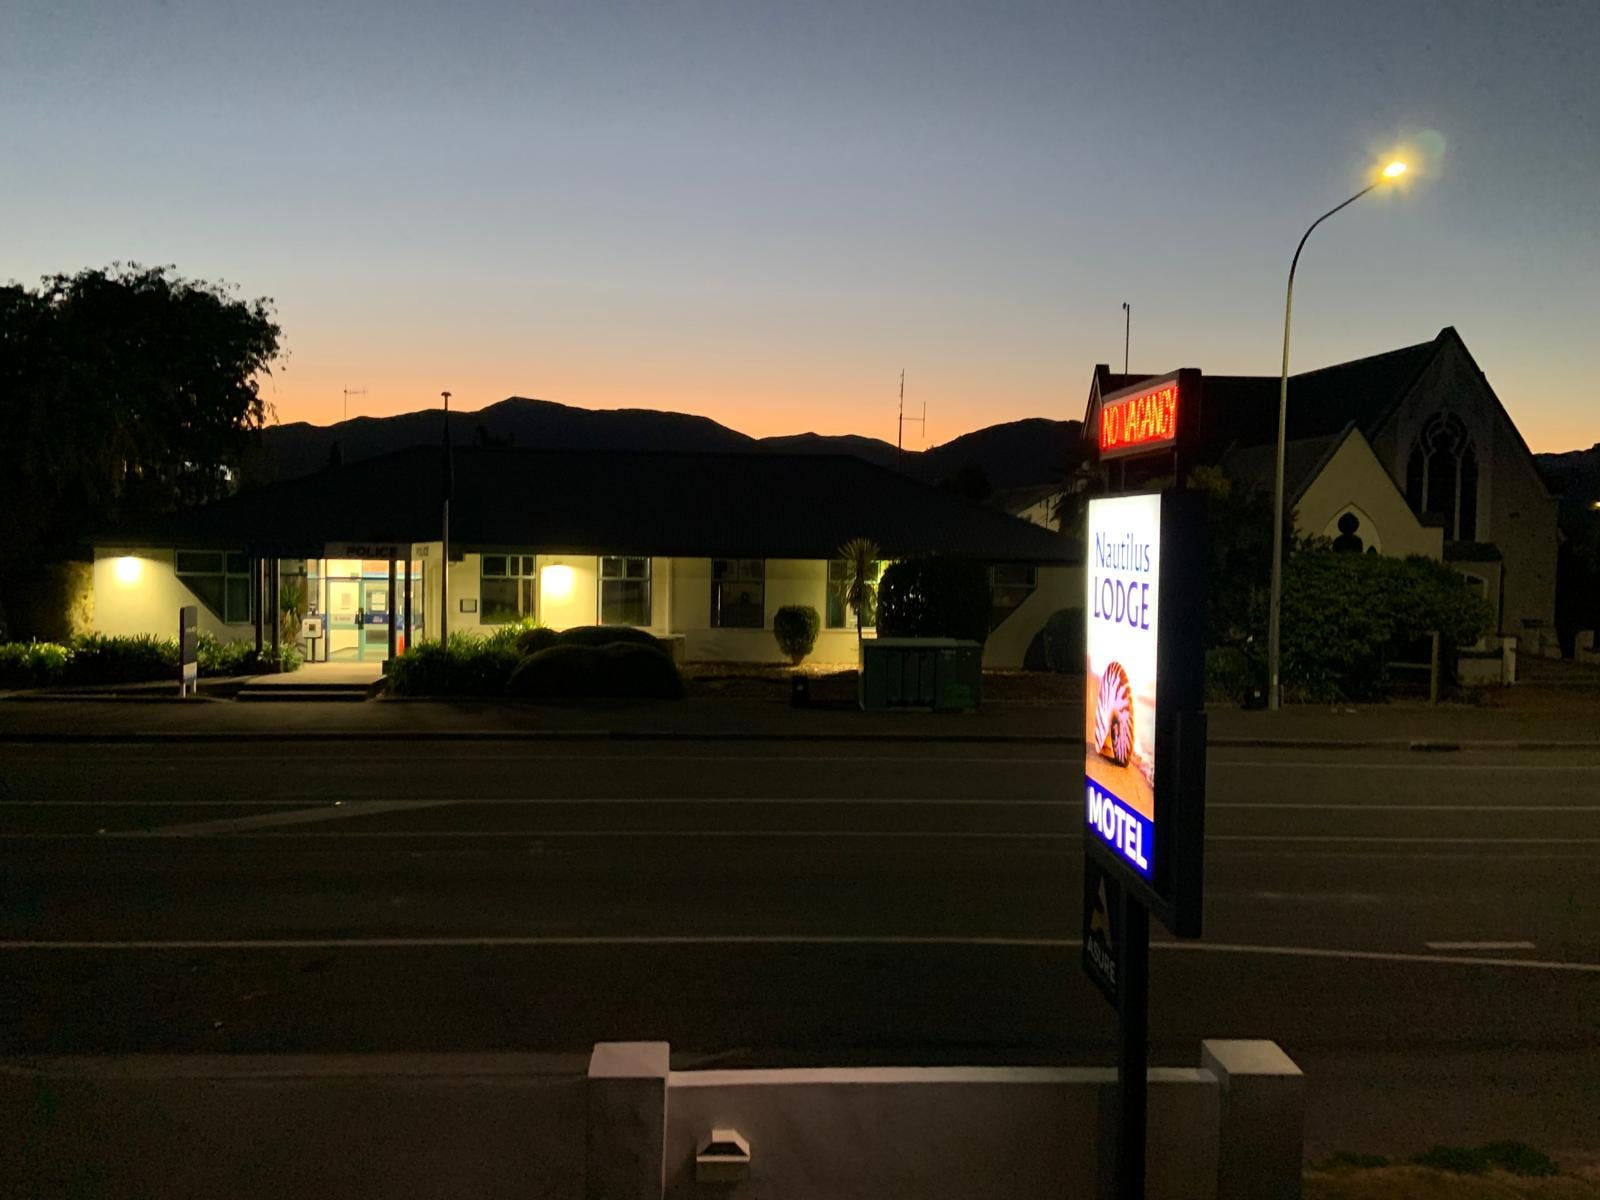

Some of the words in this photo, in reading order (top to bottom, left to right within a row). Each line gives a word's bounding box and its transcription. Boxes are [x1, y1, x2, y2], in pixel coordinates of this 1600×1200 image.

[1103, 407, 1119, 448] NO
[1123, 387, 1178, 442] VACANCY
[347, 546, 398, 557] POLICE
[1096, 532, 1150, 573] Nautilus
[1094, 576, 1150, 630] LODGE
[1088, 786, 1148, 871] MOTEL
